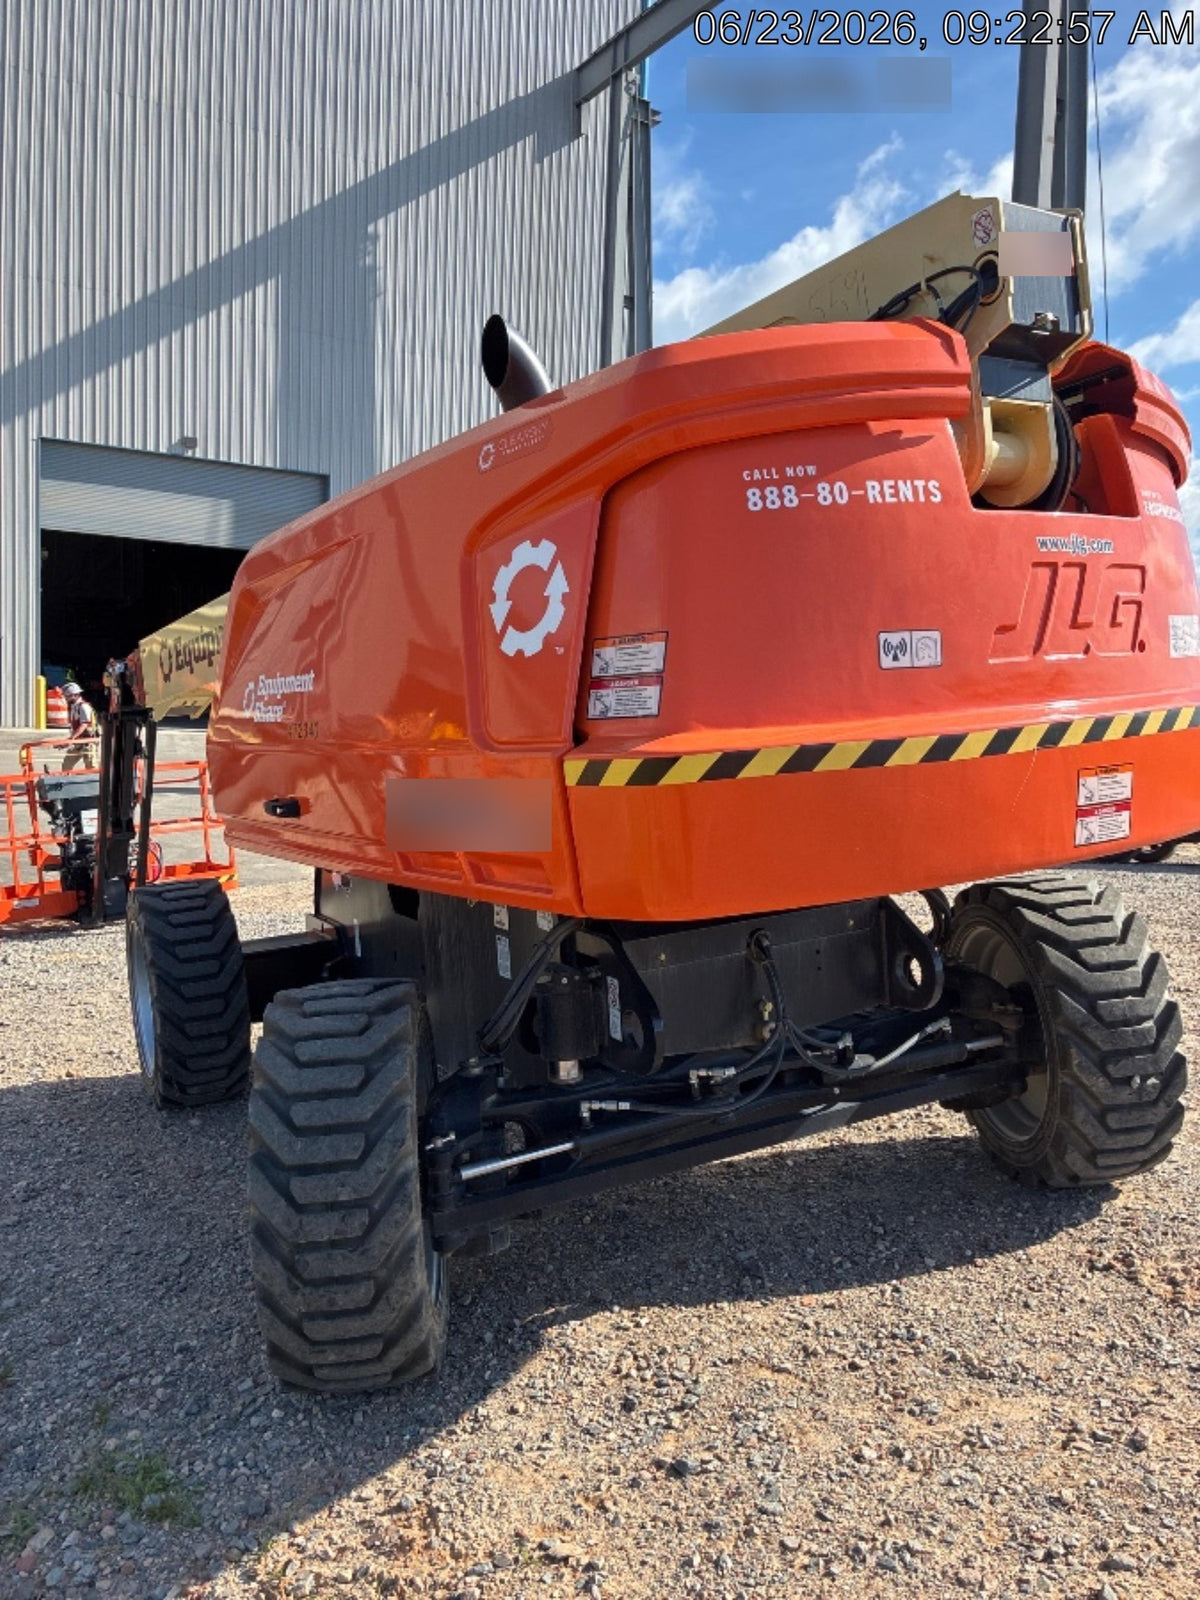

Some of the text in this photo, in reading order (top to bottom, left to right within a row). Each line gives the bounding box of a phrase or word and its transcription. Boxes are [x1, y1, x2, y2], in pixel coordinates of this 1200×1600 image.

[743, 465, 817, 481] CALL NOW
[746, 480, 942, 511] 888-80-RENTS
[1037, 534, 1113, 554] www.jlg.com
[257, 669, 315, 700] Equipment
